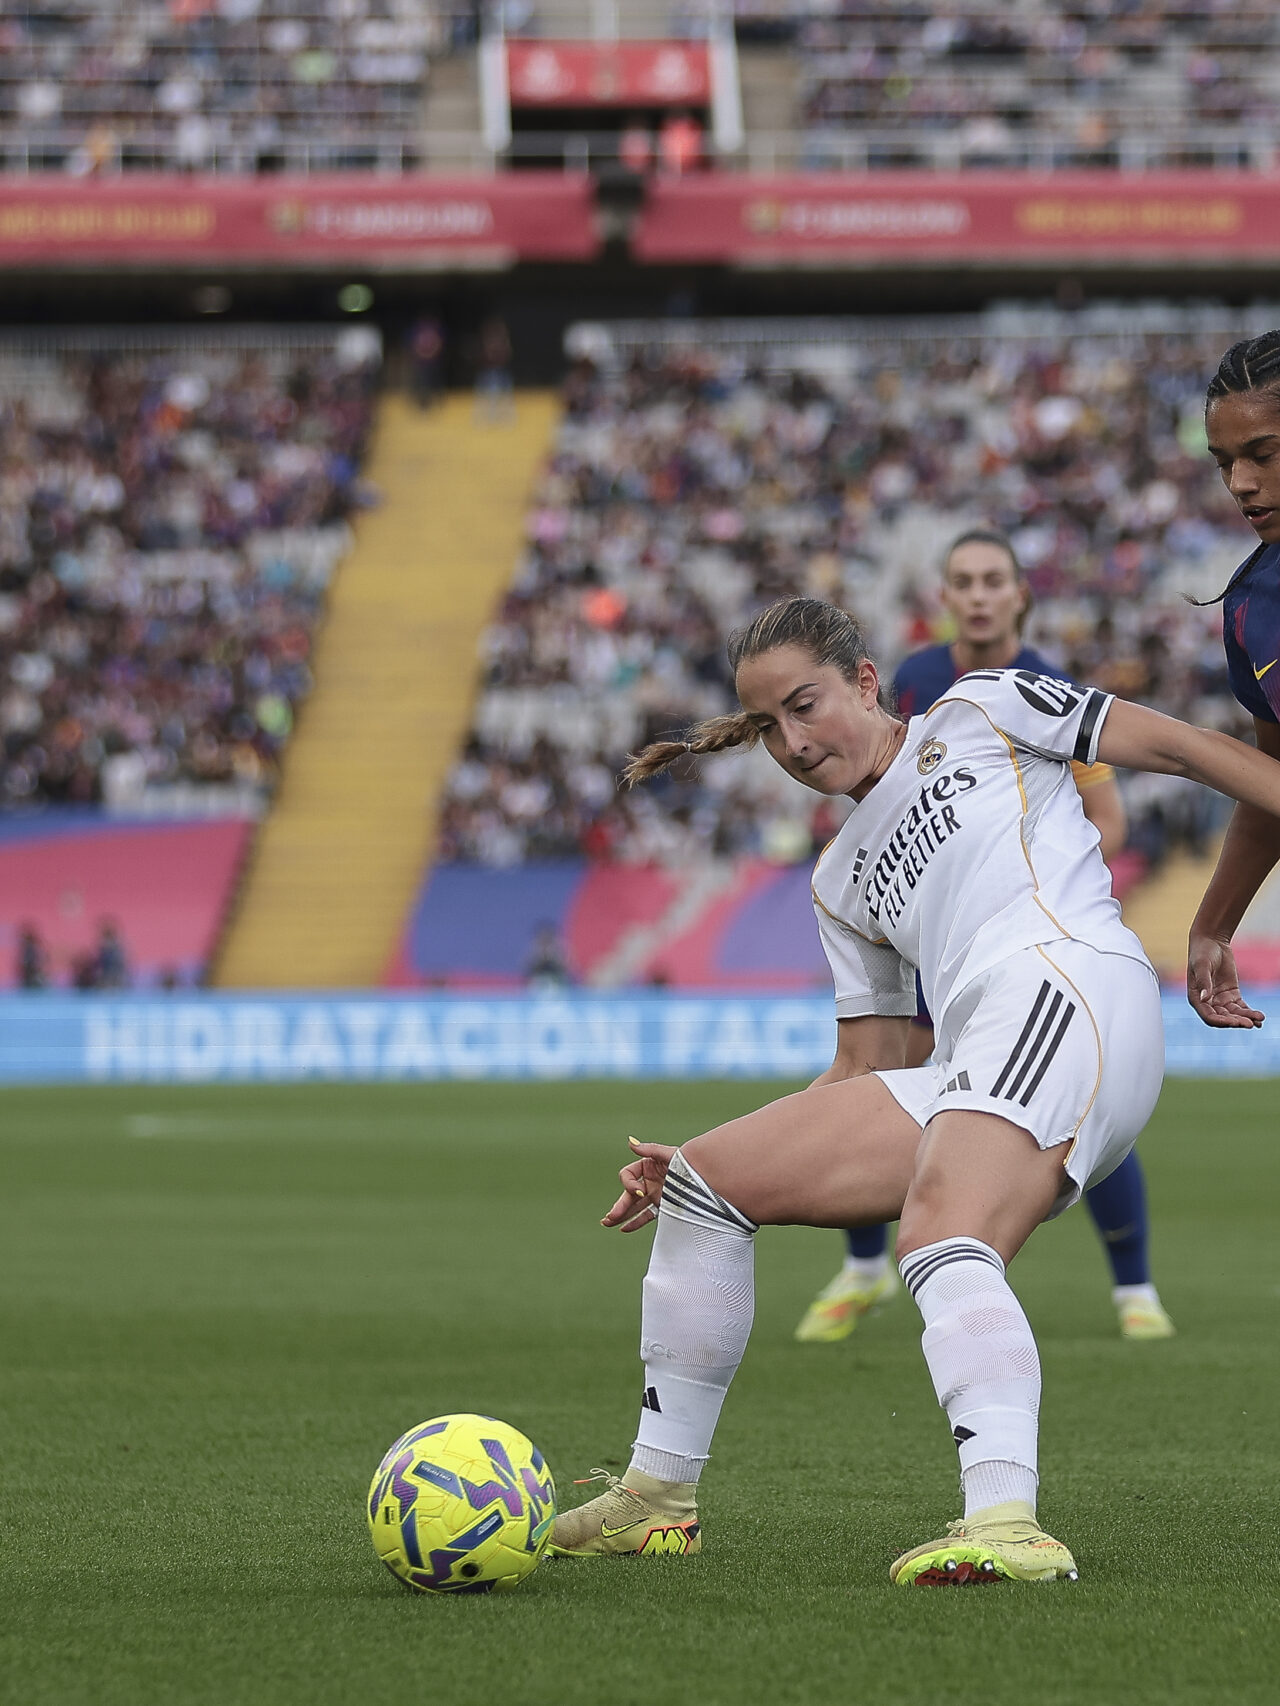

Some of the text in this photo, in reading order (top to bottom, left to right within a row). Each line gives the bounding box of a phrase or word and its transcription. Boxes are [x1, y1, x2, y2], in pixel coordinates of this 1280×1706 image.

[865, 767, 977, 921] Emirates
[884, 804, 962, 929] FLY BETTER
[86, 992, 642, 1078] HIDRATACIÓN
